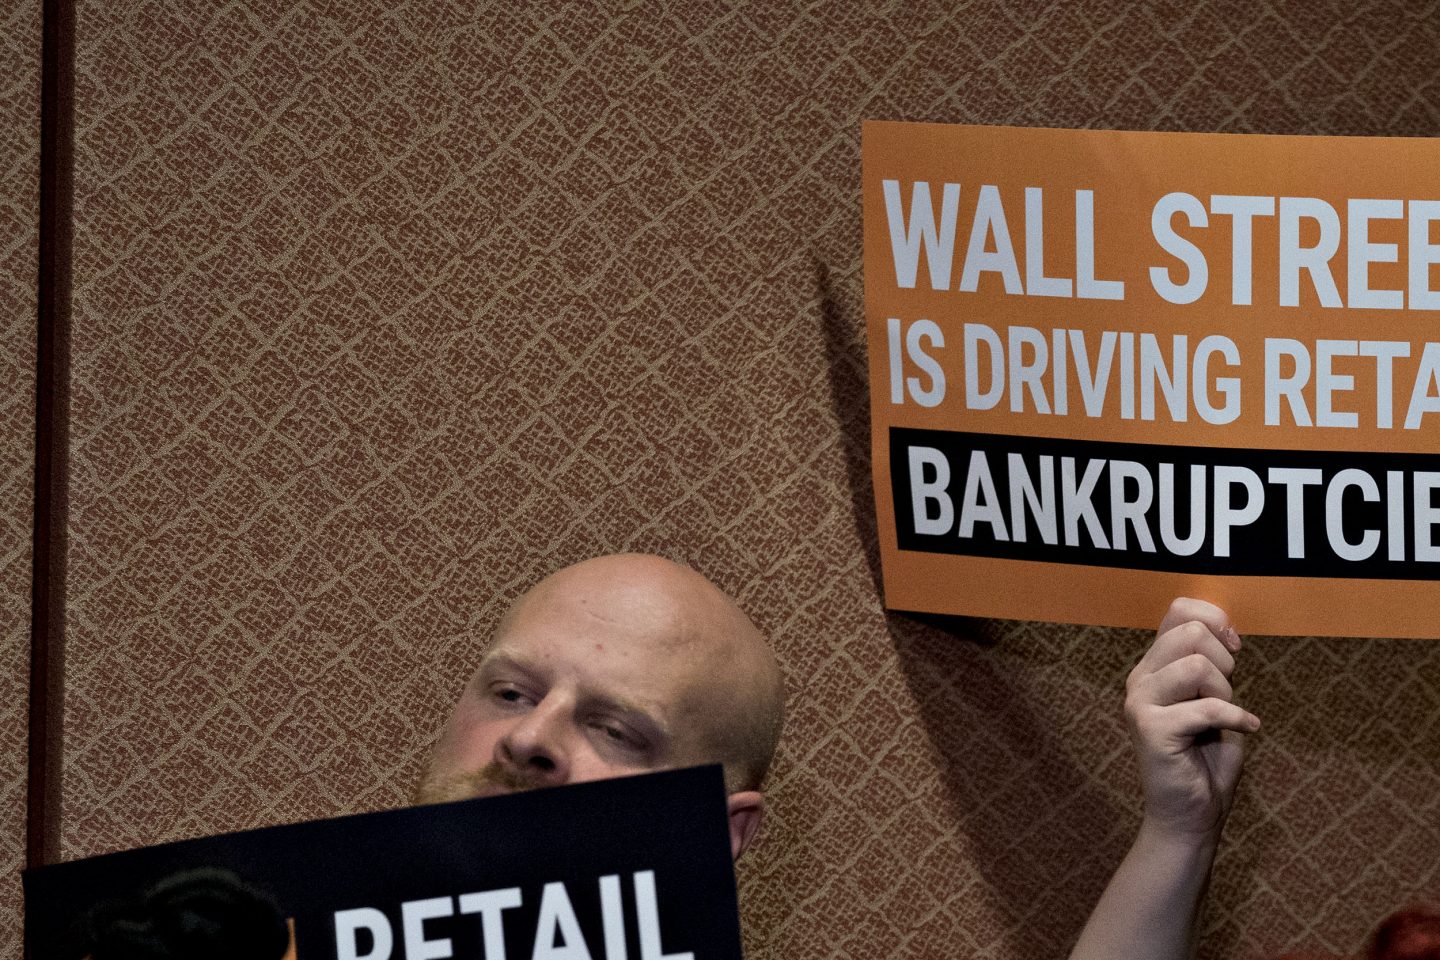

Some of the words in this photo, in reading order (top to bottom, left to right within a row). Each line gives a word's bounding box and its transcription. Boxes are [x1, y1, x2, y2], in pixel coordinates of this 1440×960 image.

[882, 179, 1125, 301] WALL
[887, 318, 946, 408] IS
[963, 323, 1242, 426] DRIVING
